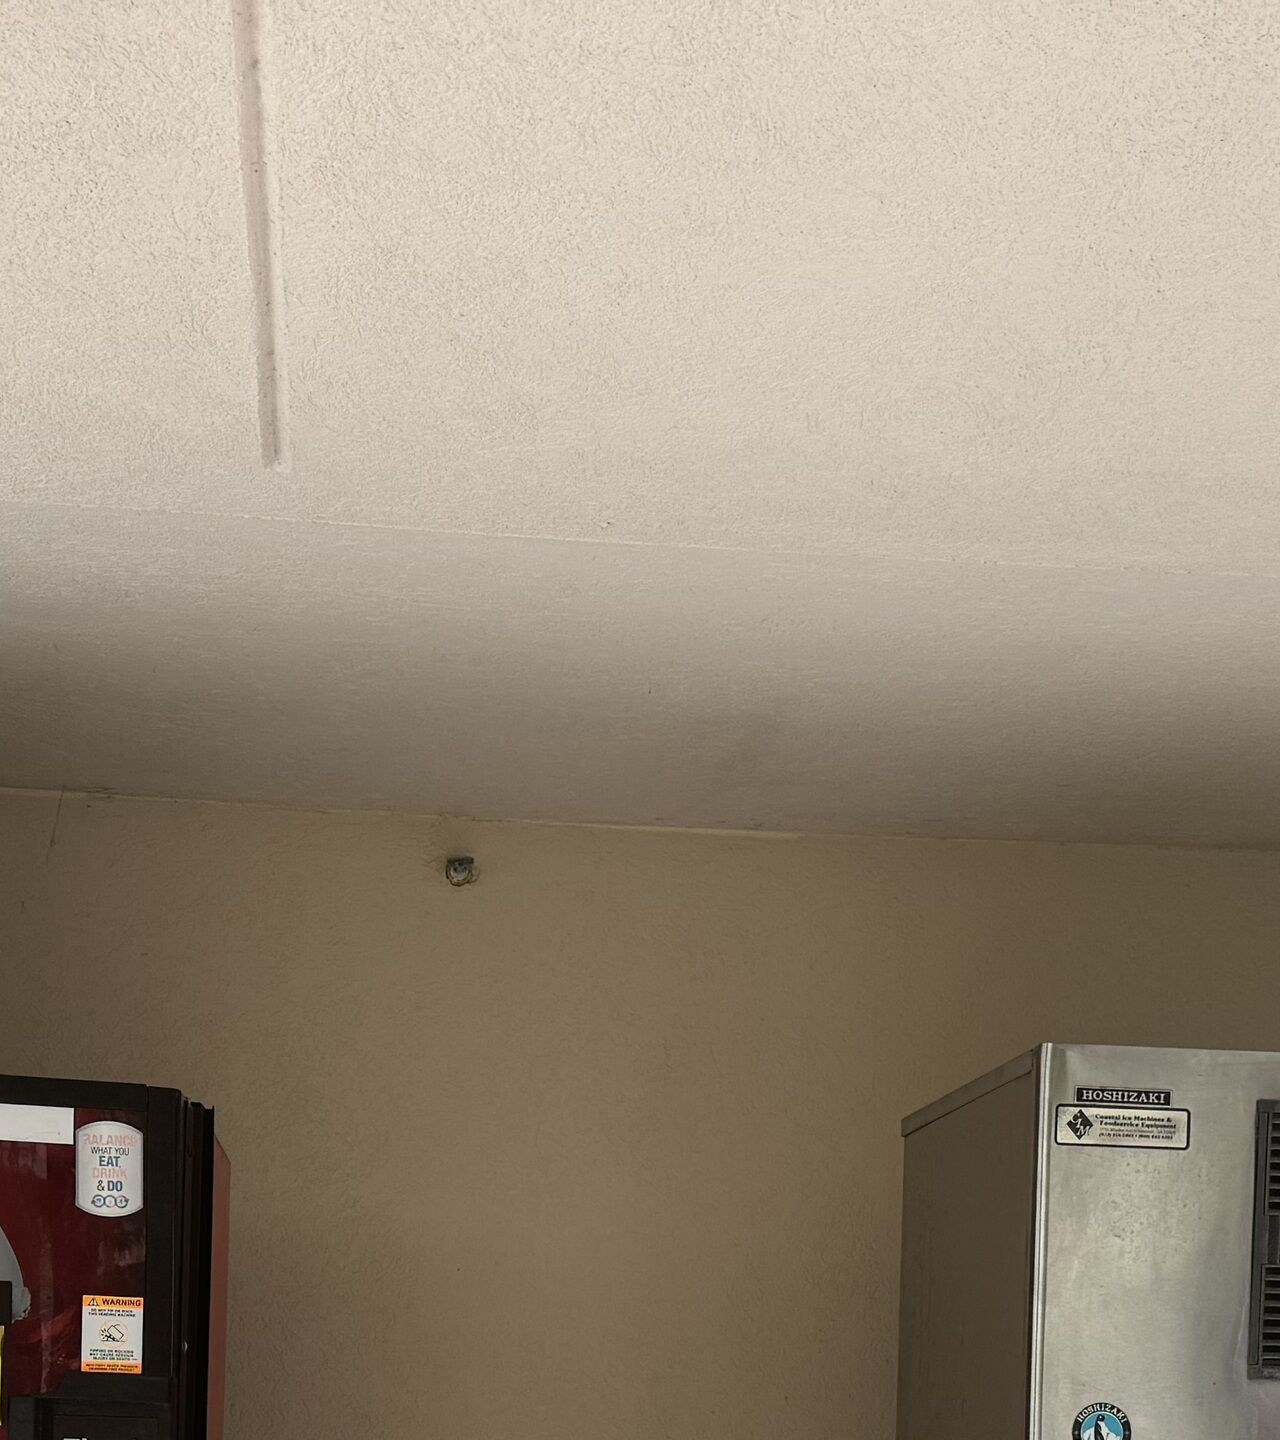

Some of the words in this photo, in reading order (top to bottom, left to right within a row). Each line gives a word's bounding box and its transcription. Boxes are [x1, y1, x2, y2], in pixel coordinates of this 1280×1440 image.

[1082, 1090, 1165, 1104] HOSHIZAKI
[91, 1147, 112, 1155] WHAT
[114, 1147, 130, 1156] YOU
[92, 1167, 128, 1180] DRINK
[96, 1180, 105, 1191] &
[107, 1180, 123, 1191] DO
[102, 1298, 141, 1307] WARNING
[1076, 1403, 1128, 1423] HOSHIZAKI
